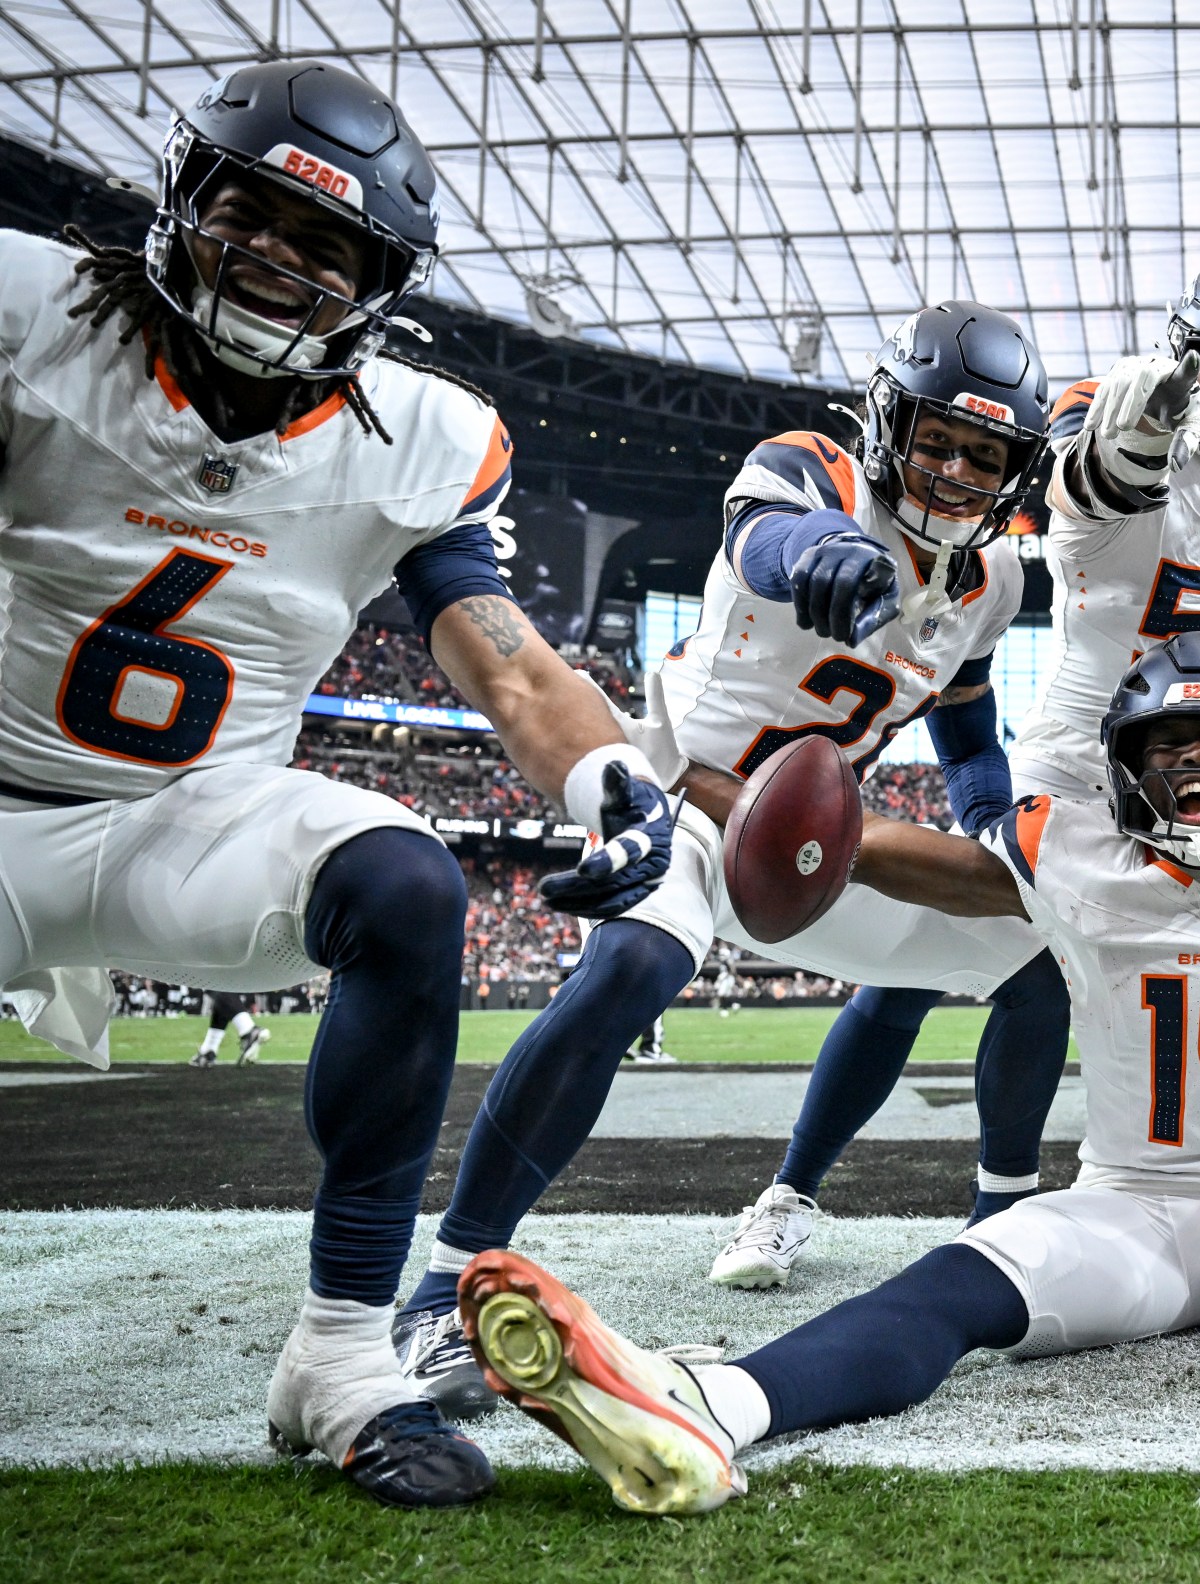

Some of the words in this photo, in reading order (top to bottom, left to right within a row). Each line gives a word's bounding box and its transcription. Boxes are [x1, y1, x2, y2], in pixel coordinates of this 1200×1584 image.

[282, 150, 349, 198] 5280
[965, 396, 1008, 421] 5280
[203, 470, 229, 489] NFL
[124, 507, 269, 558] BRONCOS
[55, 545, 236, 768] 6
[884, 650, 938, 679] BRONCOS
